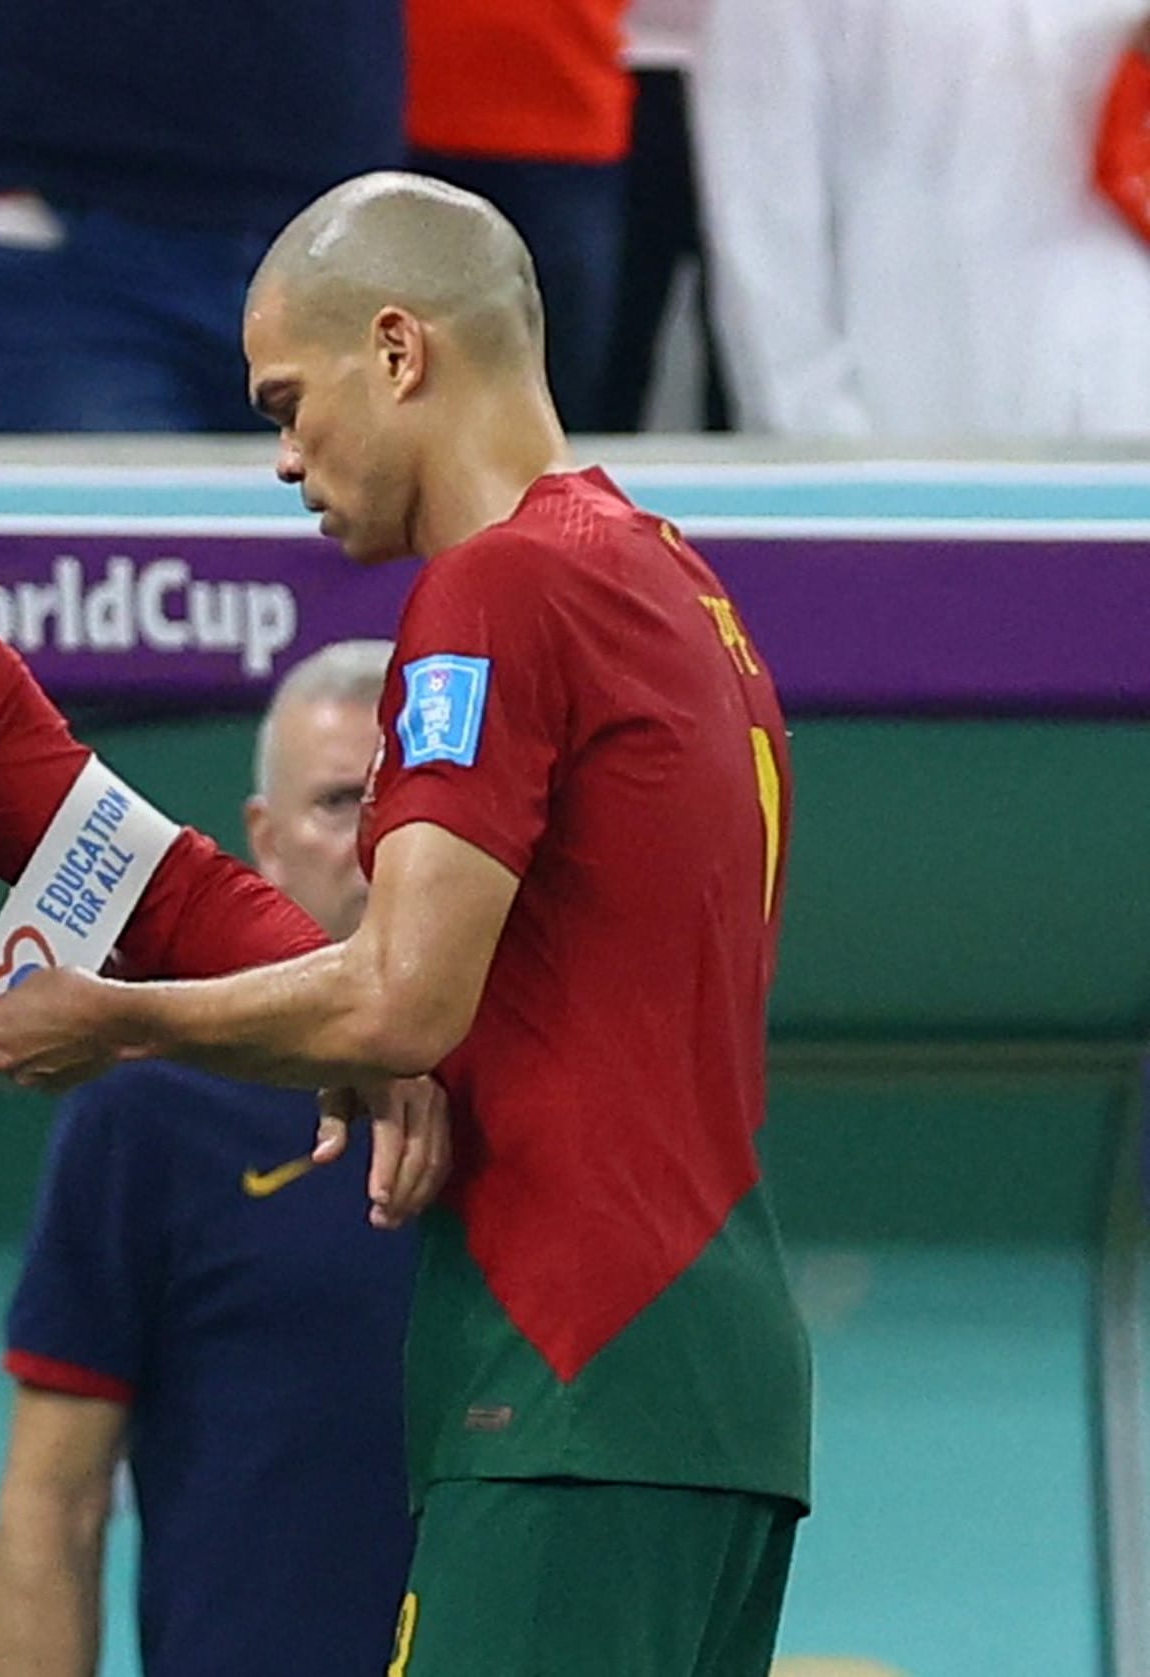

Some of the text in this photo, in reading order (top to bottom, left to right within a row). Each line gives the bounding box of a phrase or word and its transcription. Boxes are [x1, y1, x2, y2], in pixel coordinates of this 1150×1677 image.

[36, 786, 131, 923] EDUCATION
[65, 843, 135, 939] FOR ALL
